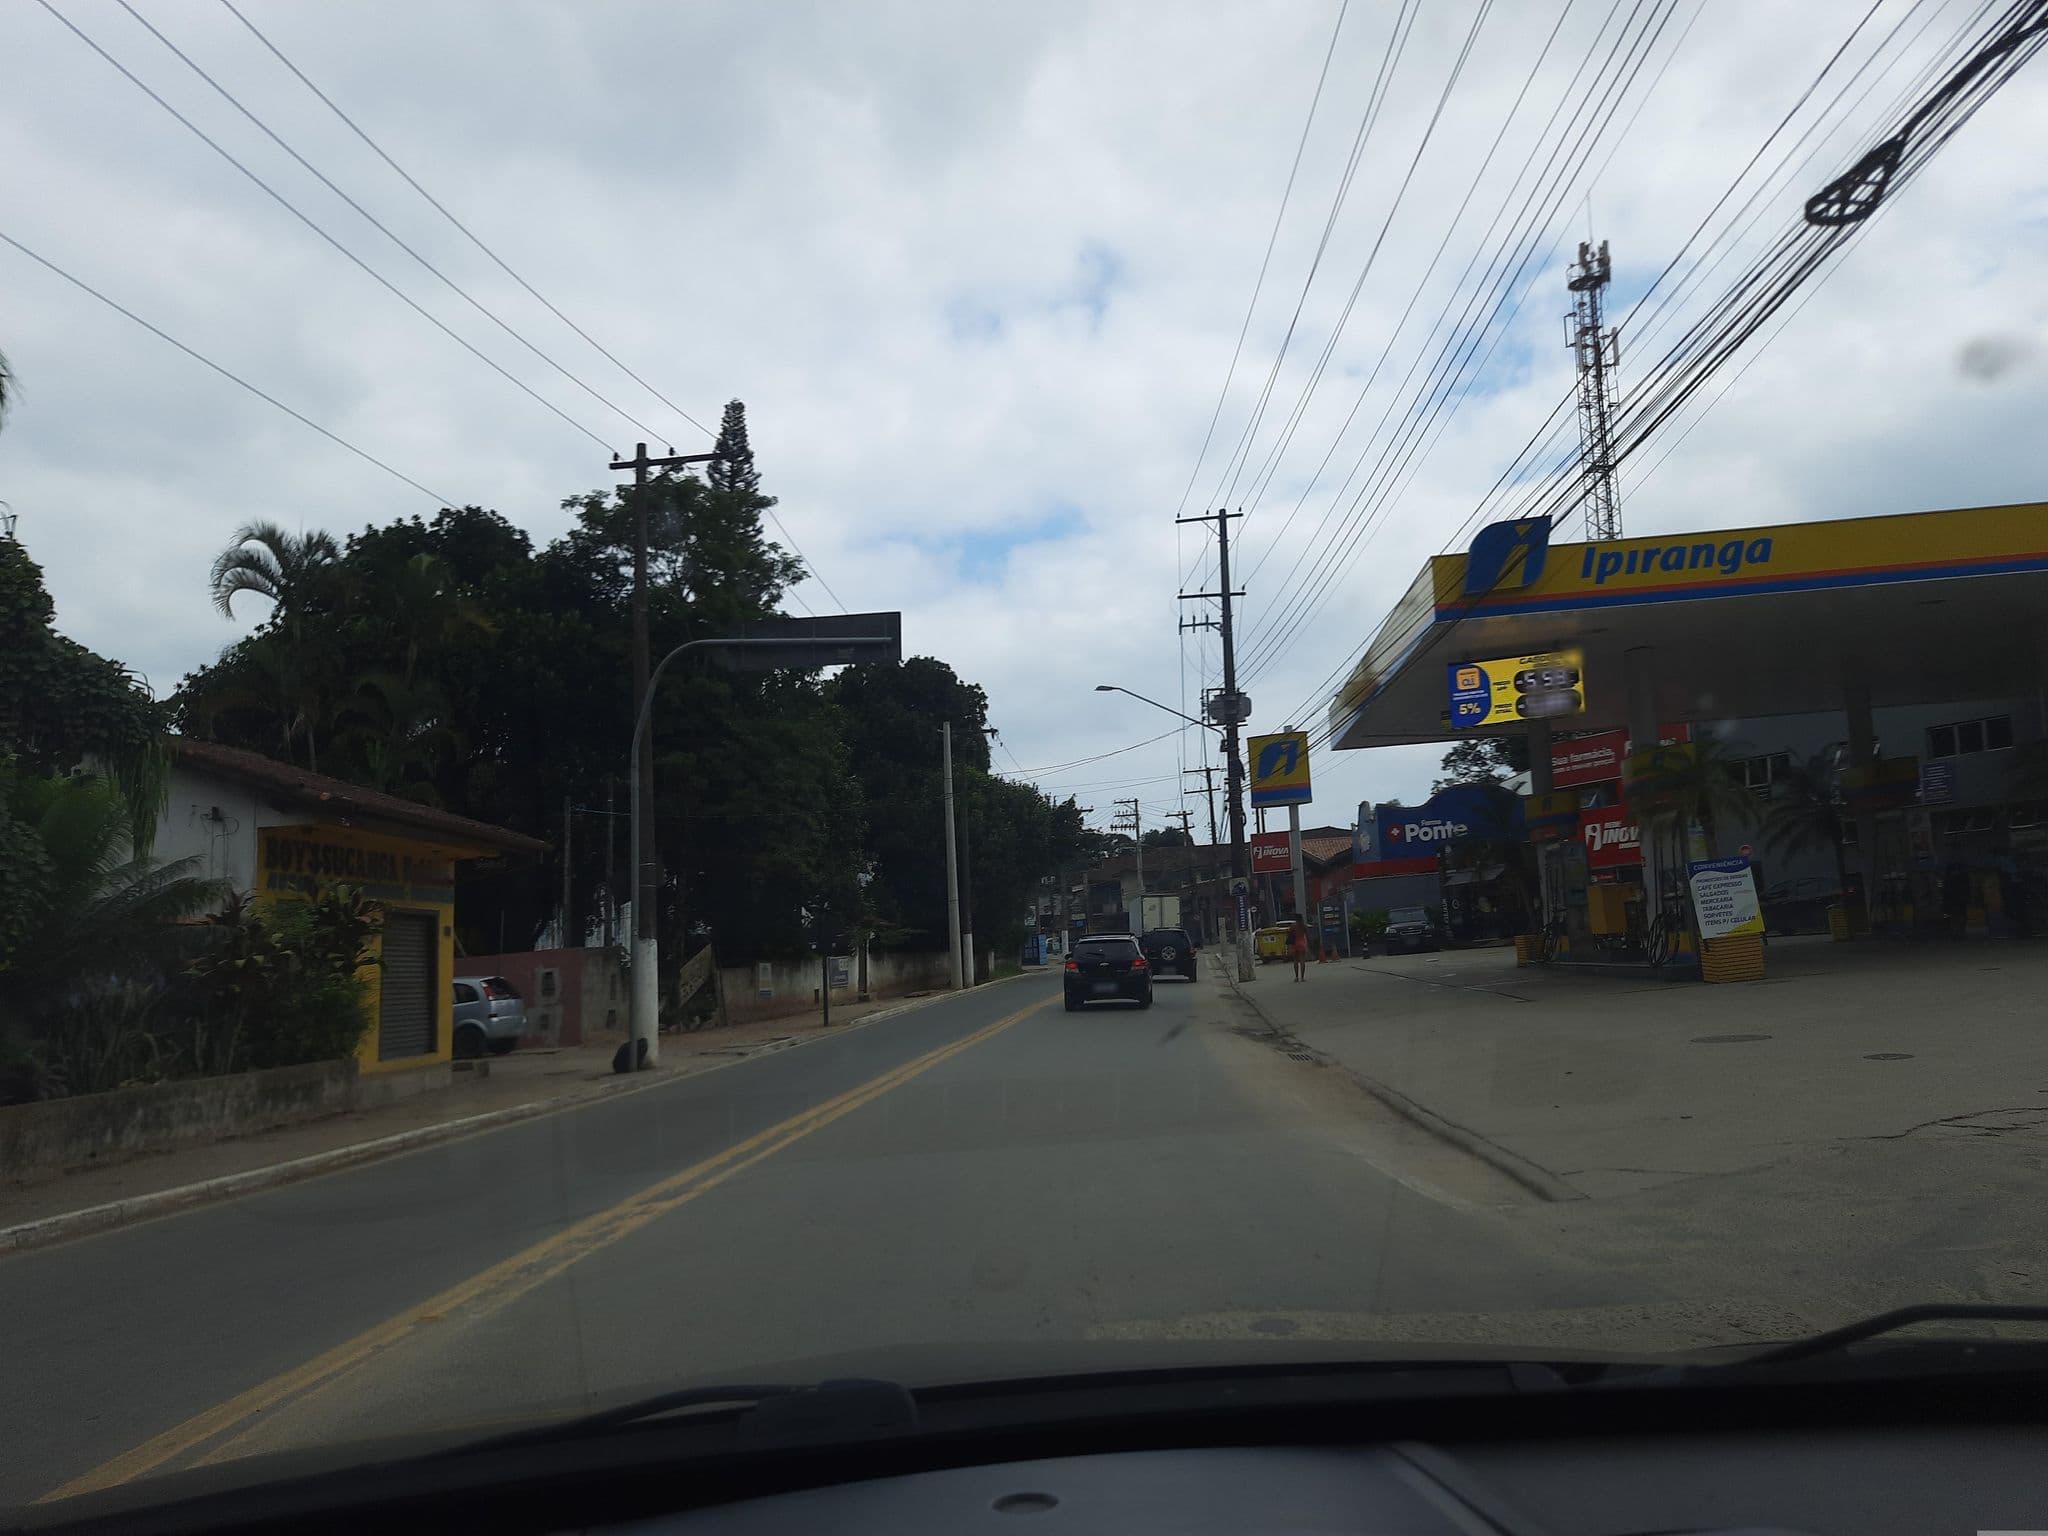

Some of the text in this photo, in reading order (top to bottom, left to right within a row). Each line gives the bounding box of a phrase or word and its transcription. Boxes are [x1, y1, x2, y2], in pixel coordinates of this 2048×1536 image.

[1581, 535, 1773, 584] Ipiranga
[1458, 702, 1482, 715] 5%
[1404, 820, 1469, 843] Ponte
